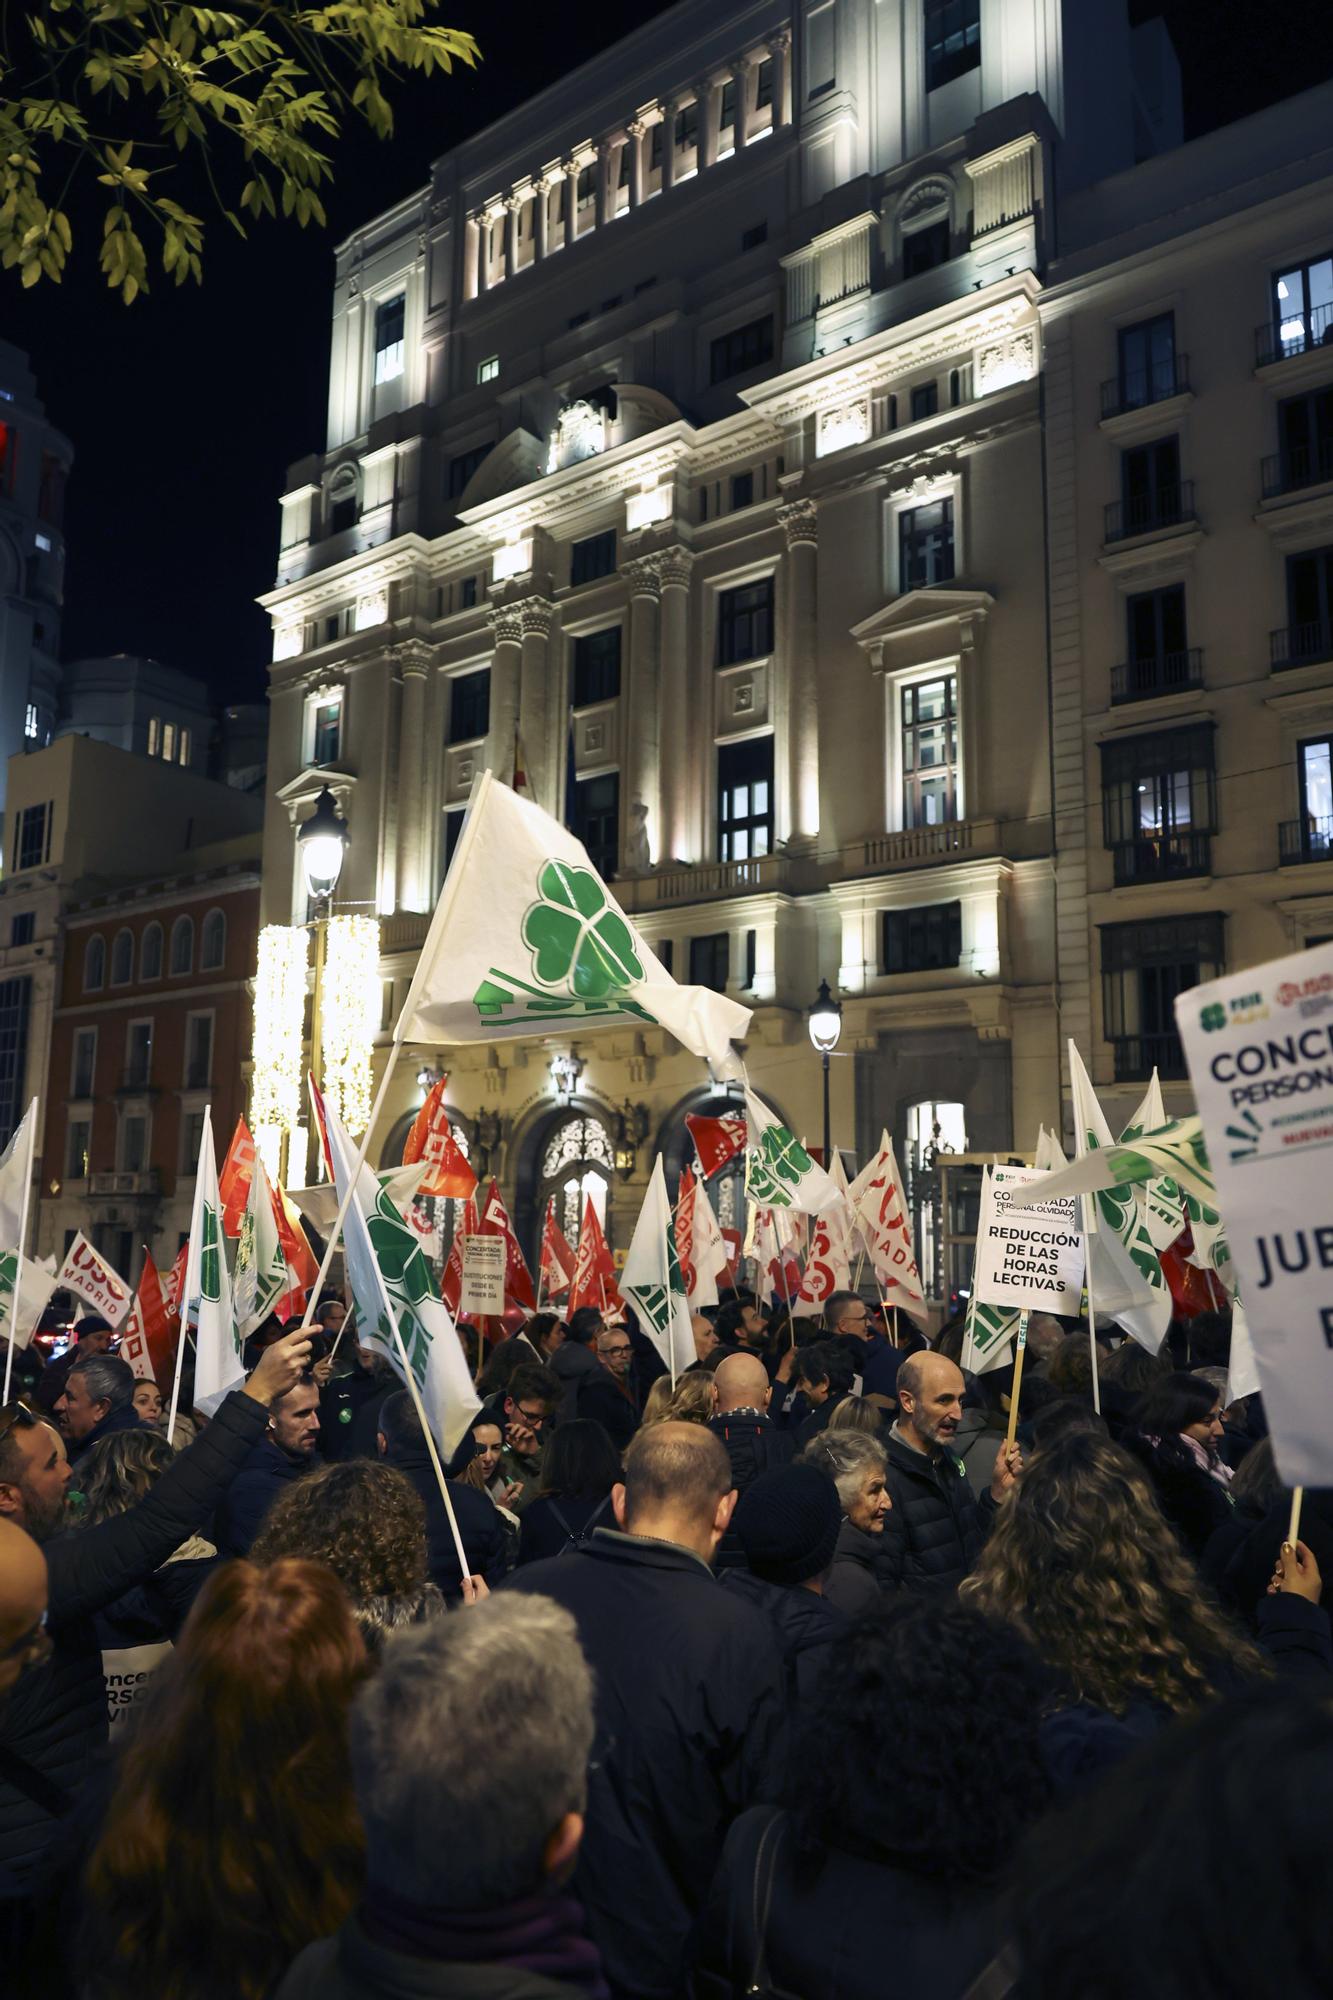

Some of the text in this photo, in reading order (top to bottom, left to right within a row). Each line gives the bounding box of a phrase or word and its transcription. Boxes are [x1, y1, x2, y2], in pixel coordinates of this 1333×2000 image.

[996, 1201, 1036, 1213] PERSNAL
[988, 1225, 1080, 1248] REDUCCIÓN
[1005, 1243, 1059, 1260] DE LAS
[1003, 1258, 1058, 1276] HORAS
[993, 1271, 1066, 1292] LECTIVAS
